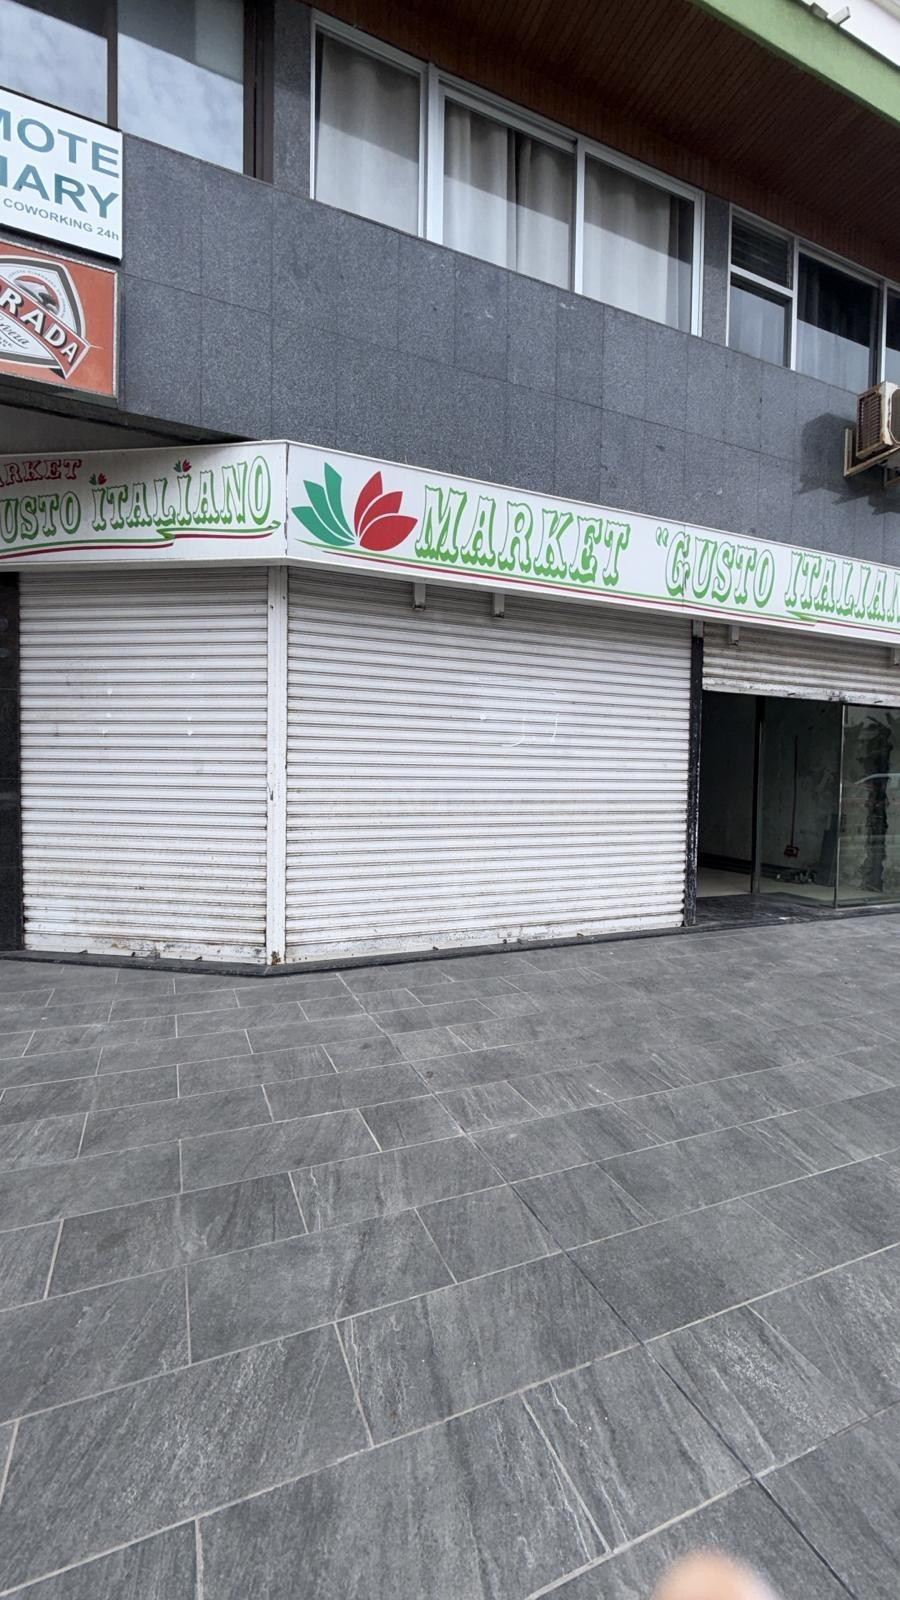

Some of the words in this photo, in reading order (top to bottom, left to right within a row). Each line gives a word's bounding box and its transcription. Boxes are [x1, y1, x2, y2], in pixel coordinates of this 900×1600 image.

[0, 154, 120, 220] ARY
[3, 198, 94, 233] COWORKING
[97, 226, 120, 241] 24h
[0, 458, 82, 488] RKET
[90, 455, 272, 532] ITALIANO
[415, 484, 631, 587] MARKET
